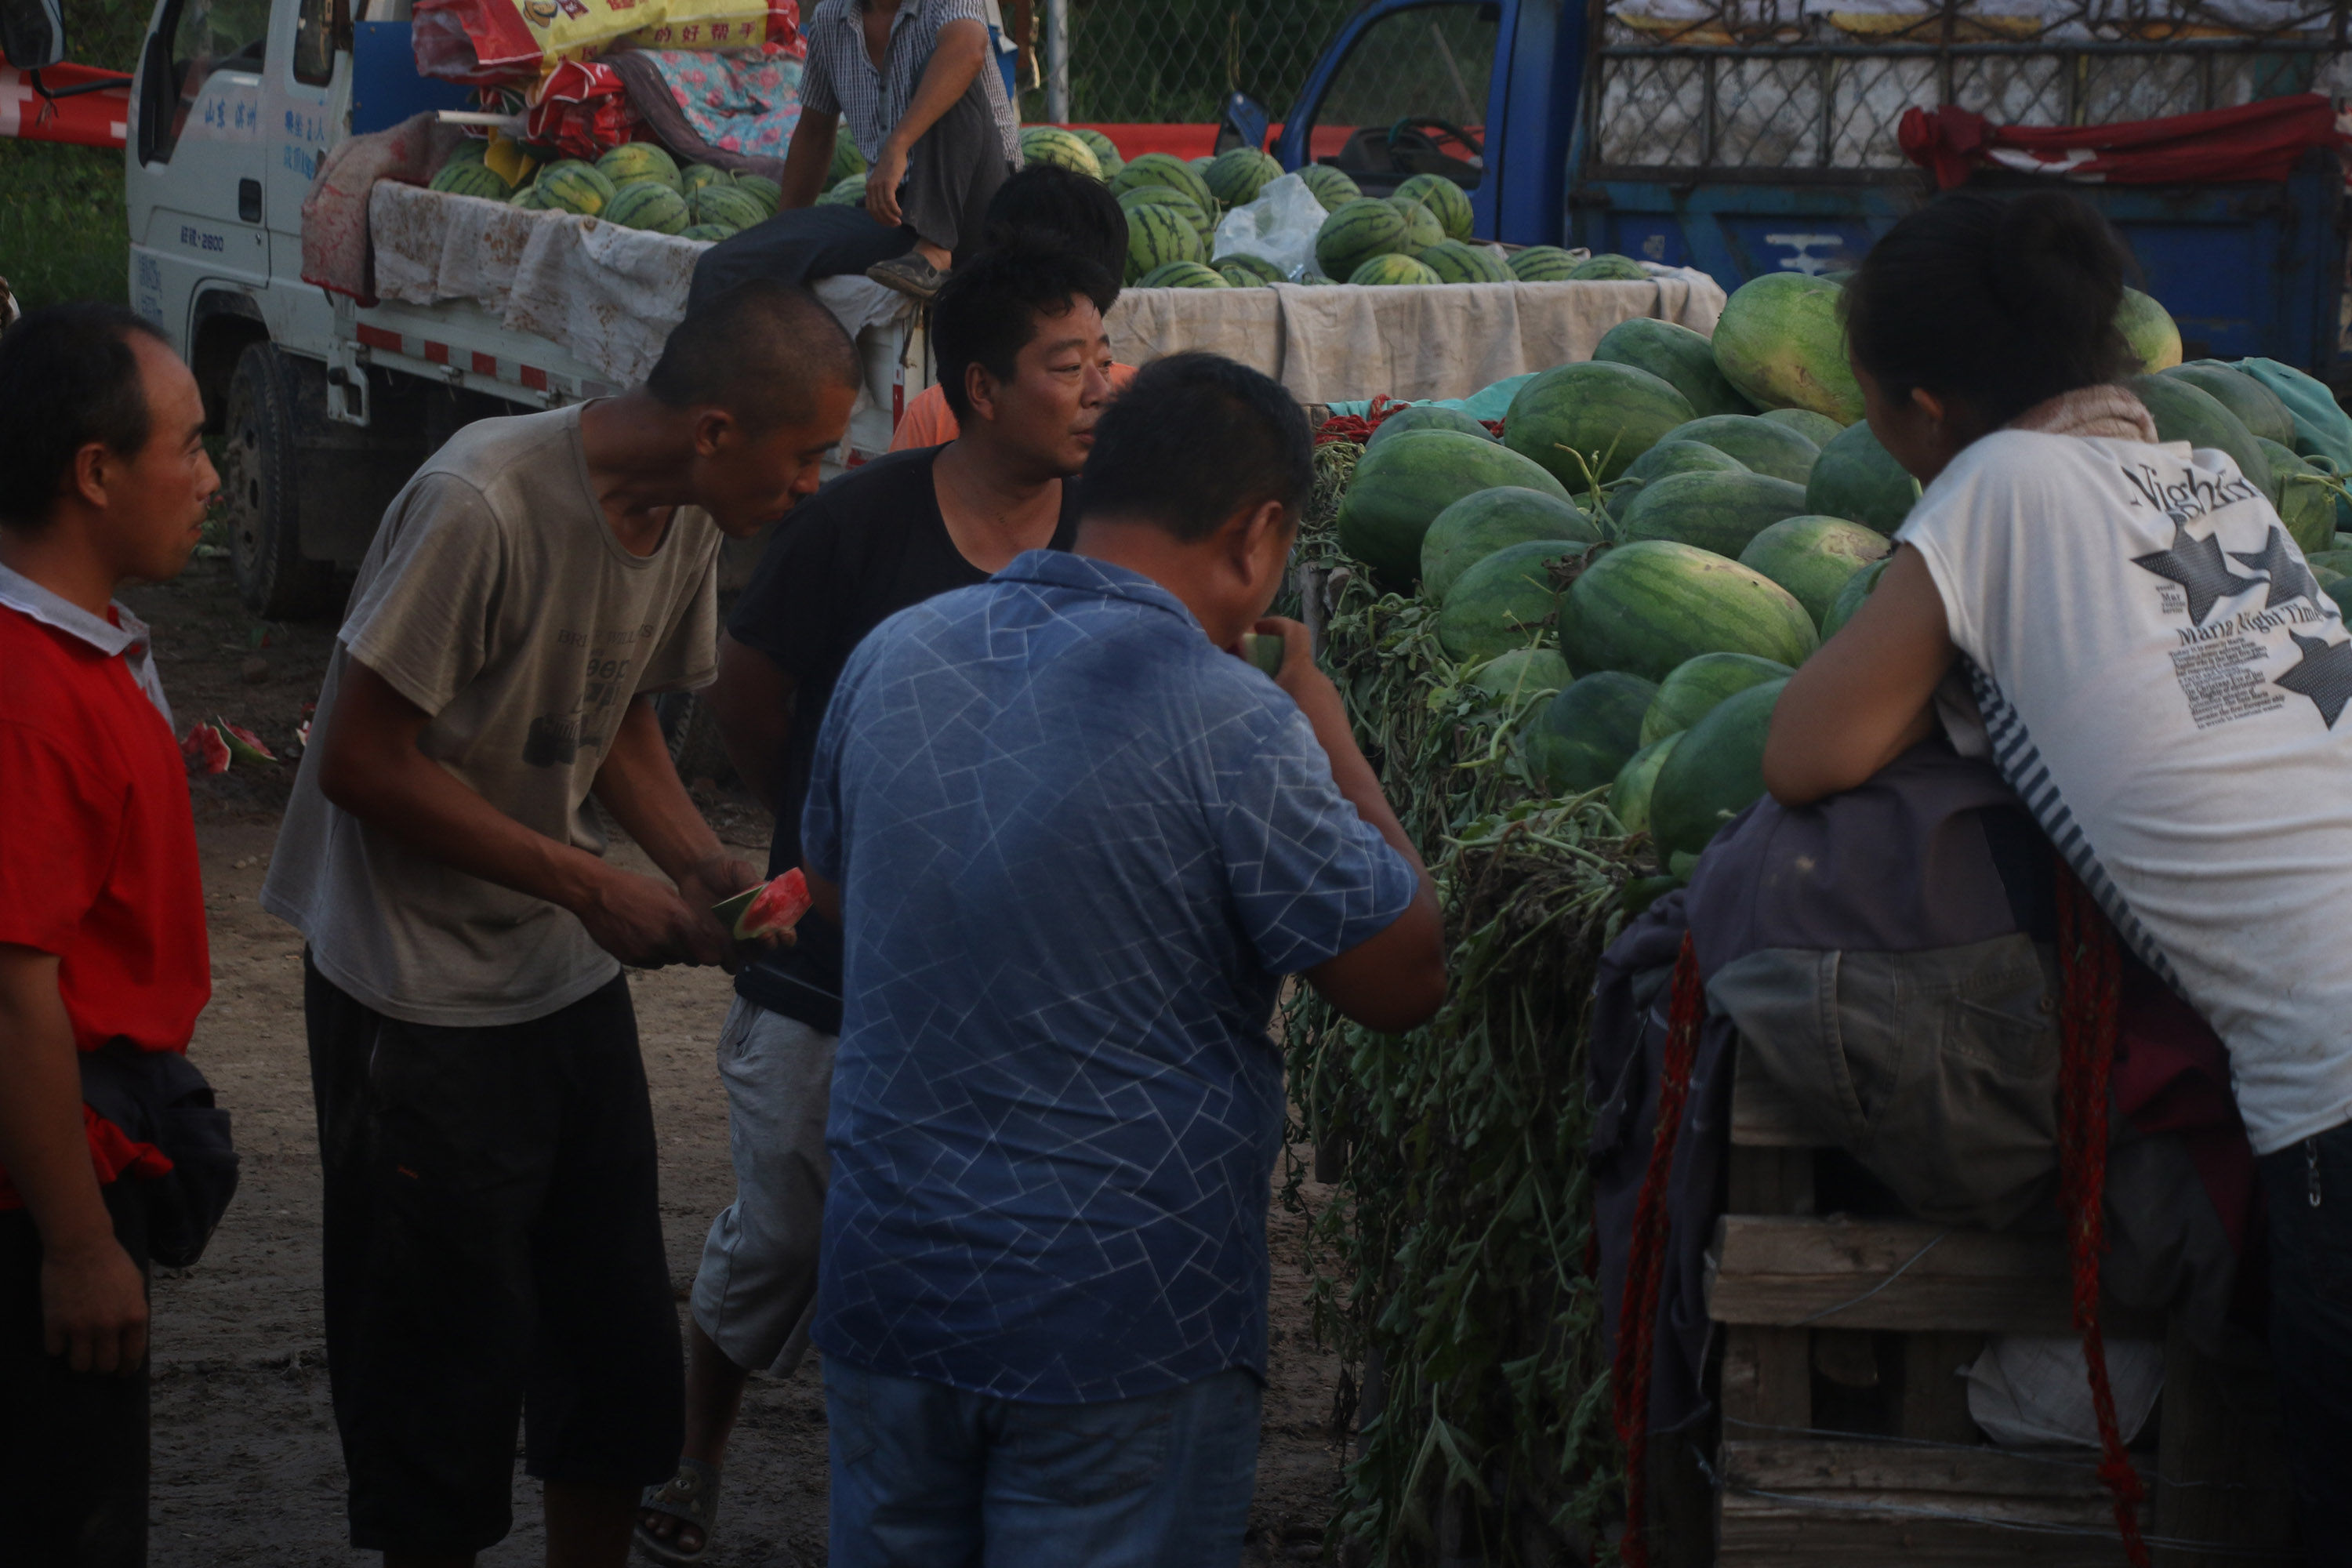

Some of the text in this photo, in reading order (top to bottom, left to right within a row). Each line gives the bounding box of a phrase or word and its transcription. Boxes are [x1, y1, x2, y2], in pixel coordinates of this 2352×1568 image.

[654, 20, 757, 43] 的好帮手
[205, 96, 226, 129] 山东
[2176, 619, 2234, 646] Maria
[2236, 609, 2285, 633] Night
